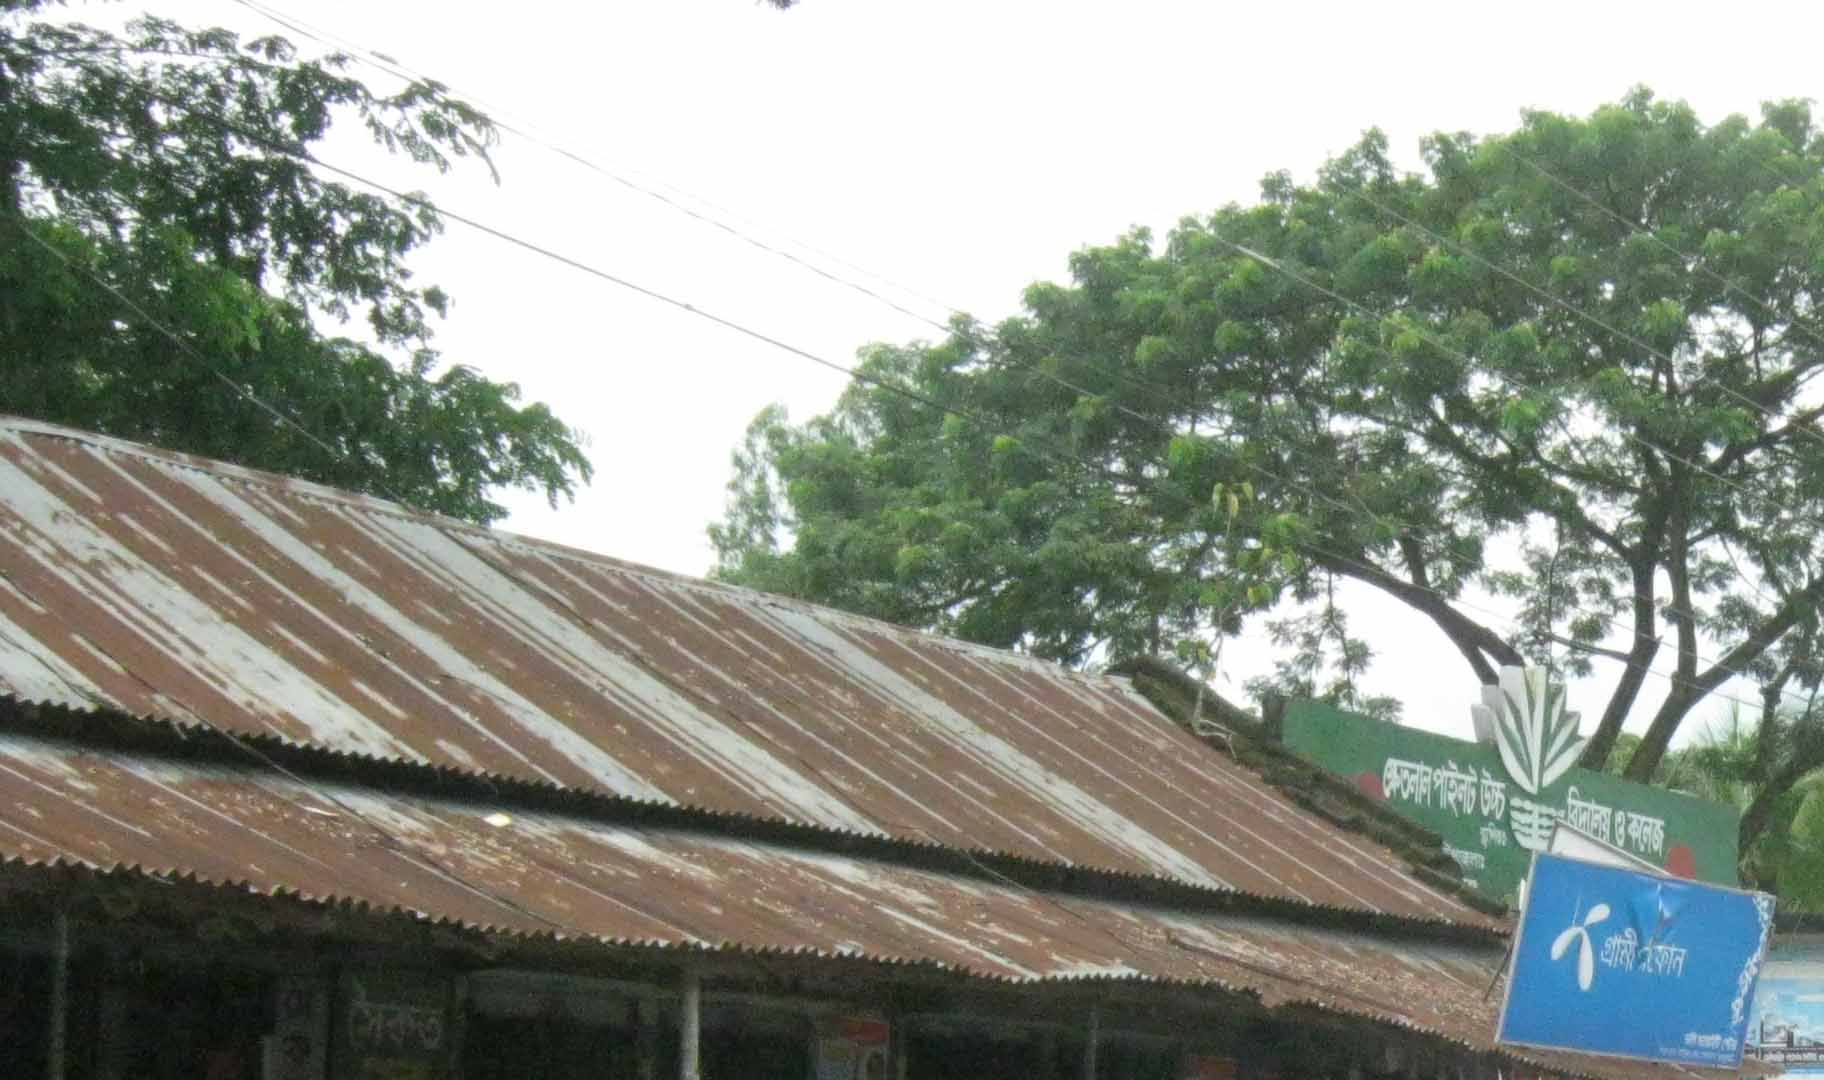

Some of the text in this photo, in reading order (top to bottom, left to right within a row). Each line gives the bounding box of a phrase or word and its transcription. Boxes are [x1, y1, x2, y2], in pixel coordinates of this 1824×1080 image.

[1382, 757, 1432, 808] ক্ষেতলাল
[1433, 759, 1478, 817] পাইলট
[1480, 767, 1507, 820] উচ্চ
[1614, 810, 1625, 848] ও
[1627, 811, 1664, 856] কলেজ
